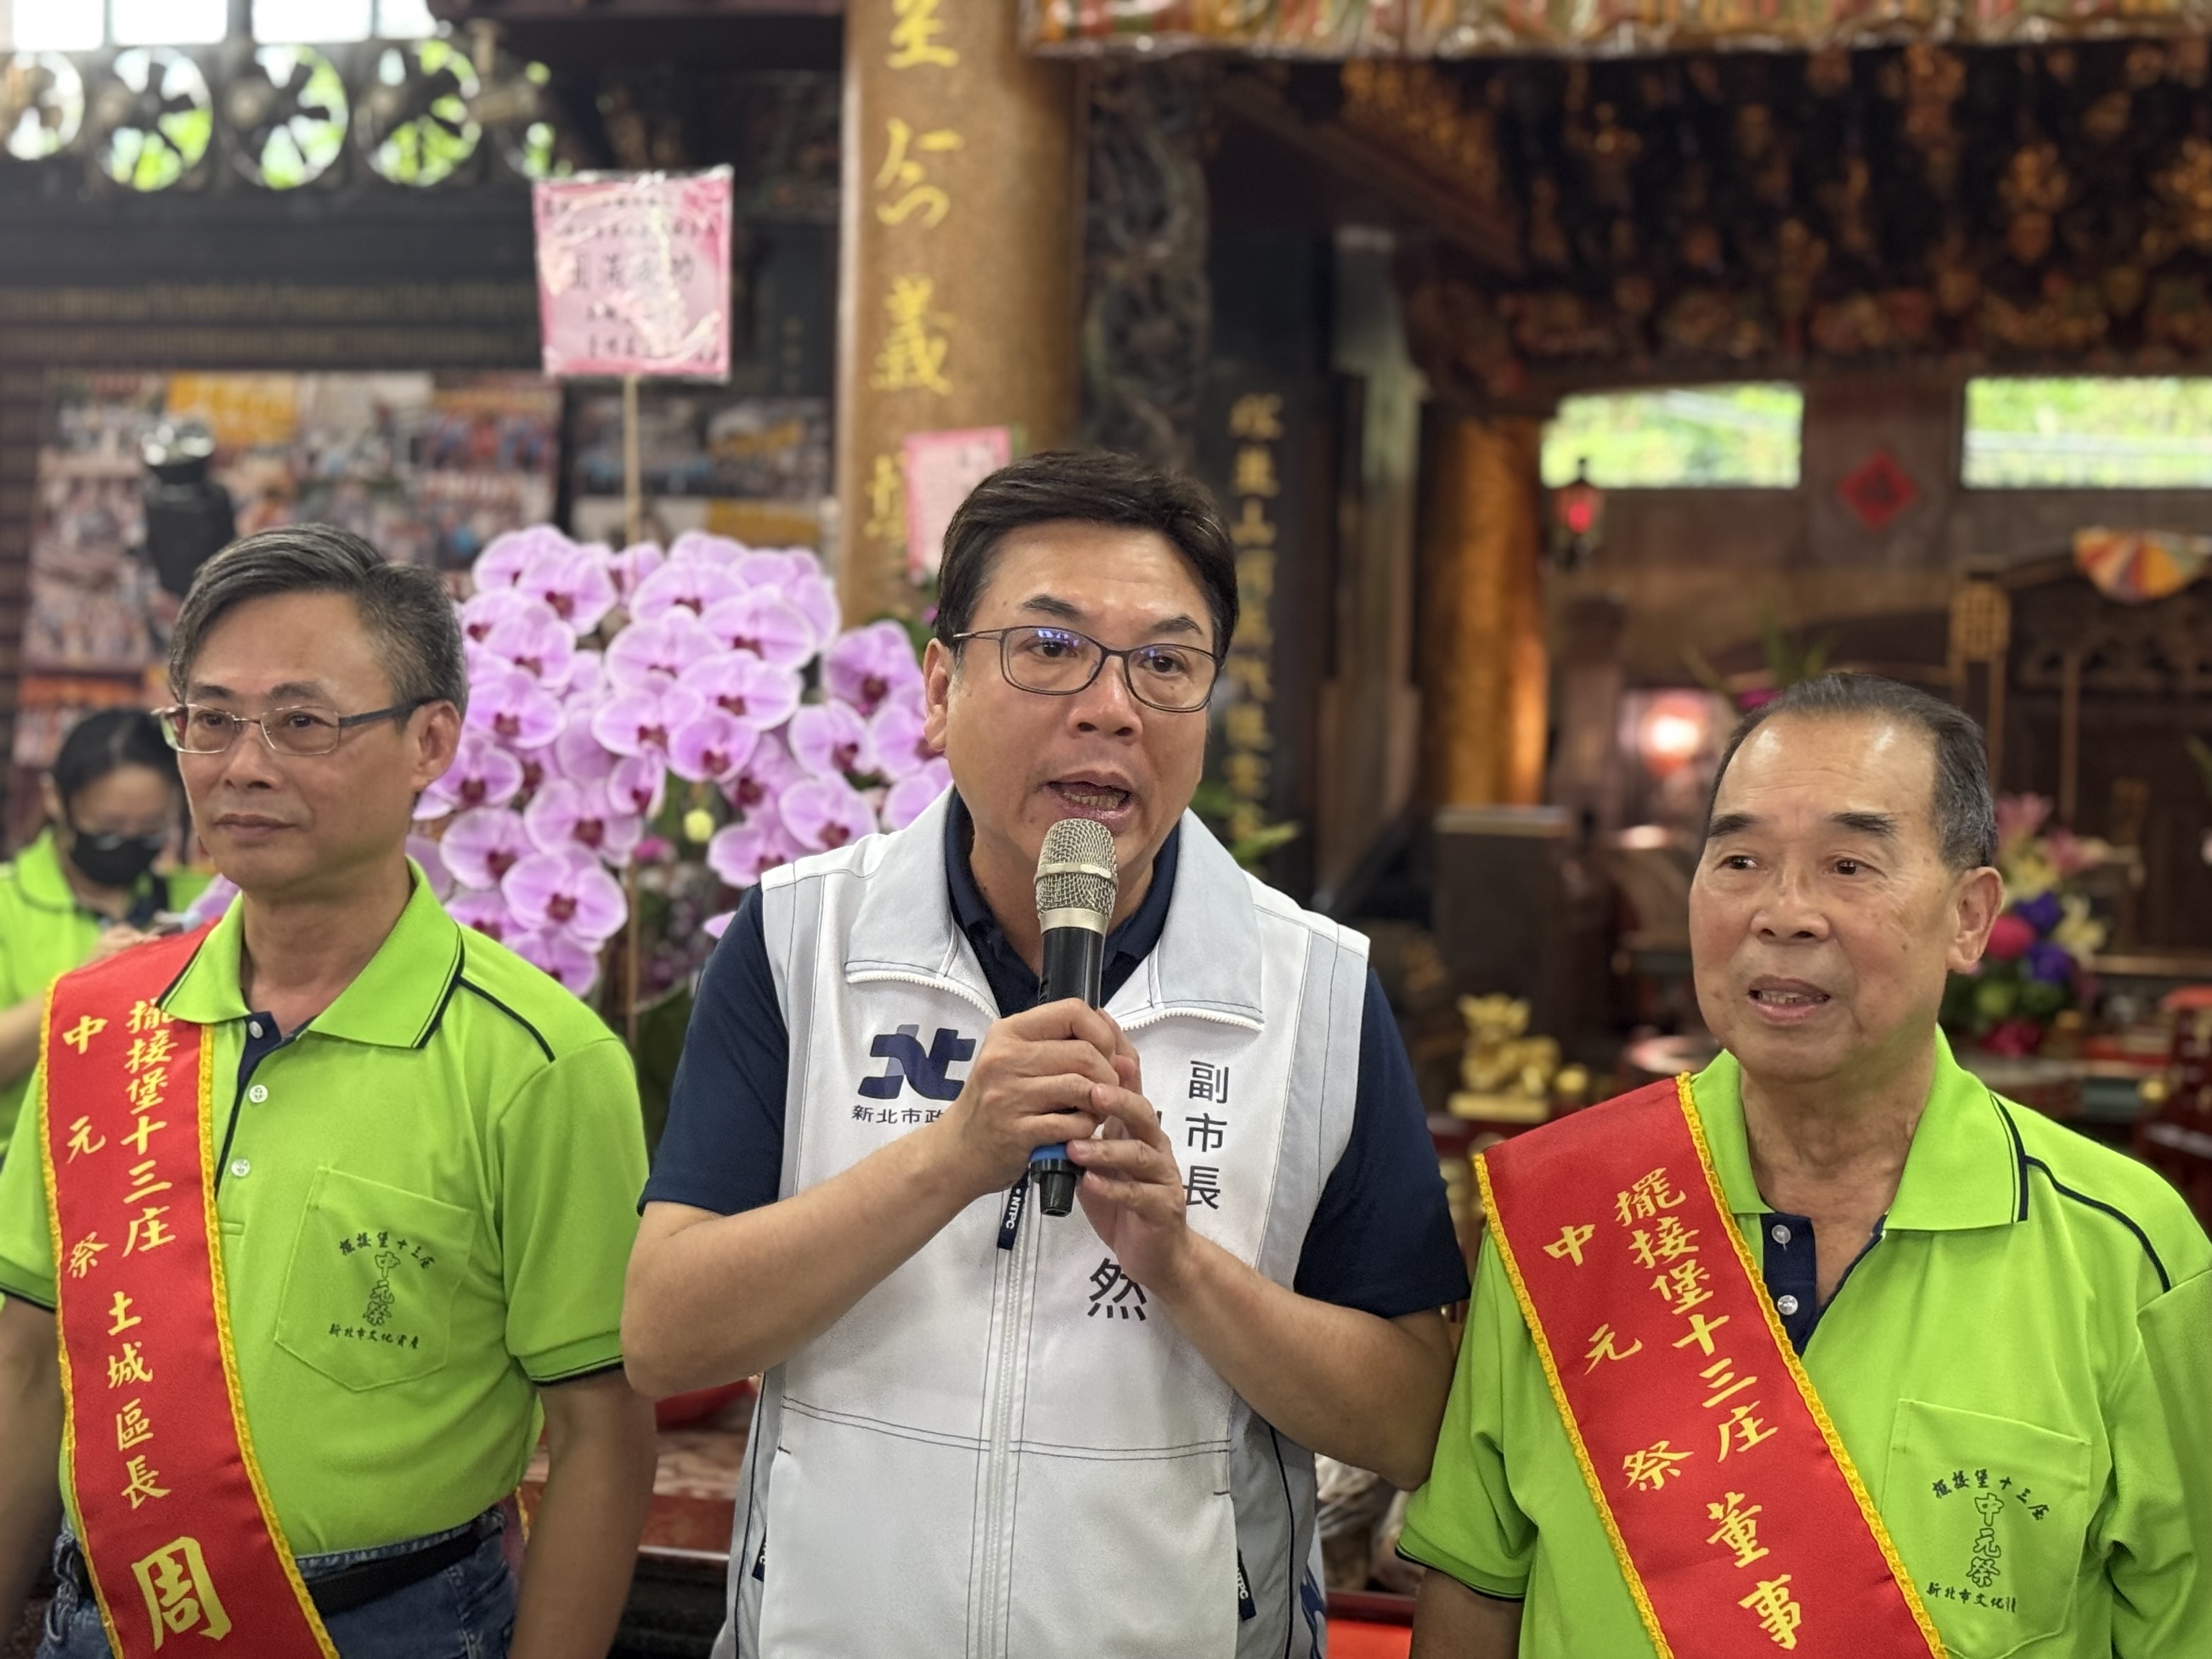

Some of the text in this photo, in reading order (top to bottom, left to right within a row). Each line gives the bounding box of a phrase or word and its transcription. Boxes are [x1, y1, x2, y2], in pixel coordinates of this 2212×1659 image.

[63, 1015, 108, 1277] 中元祭
[1183, 1060, 1229, 1210] 副市長
[362, 1251, 401, 1326] 中元祭
[1006, 1196, 1021, 1229] NTPC
[1543, 1224, 1694, 1491] 中元祭
[1615, 1167, 1778, 1463] 擺接堡十三庄
[106, 1291, 171, 1509] 土城區長
[131, 1536, 232, 1651] 周
[1706, 1492, 1802, 1650] 董事
[1966, 1492, 2005, 1588] 中元祭
